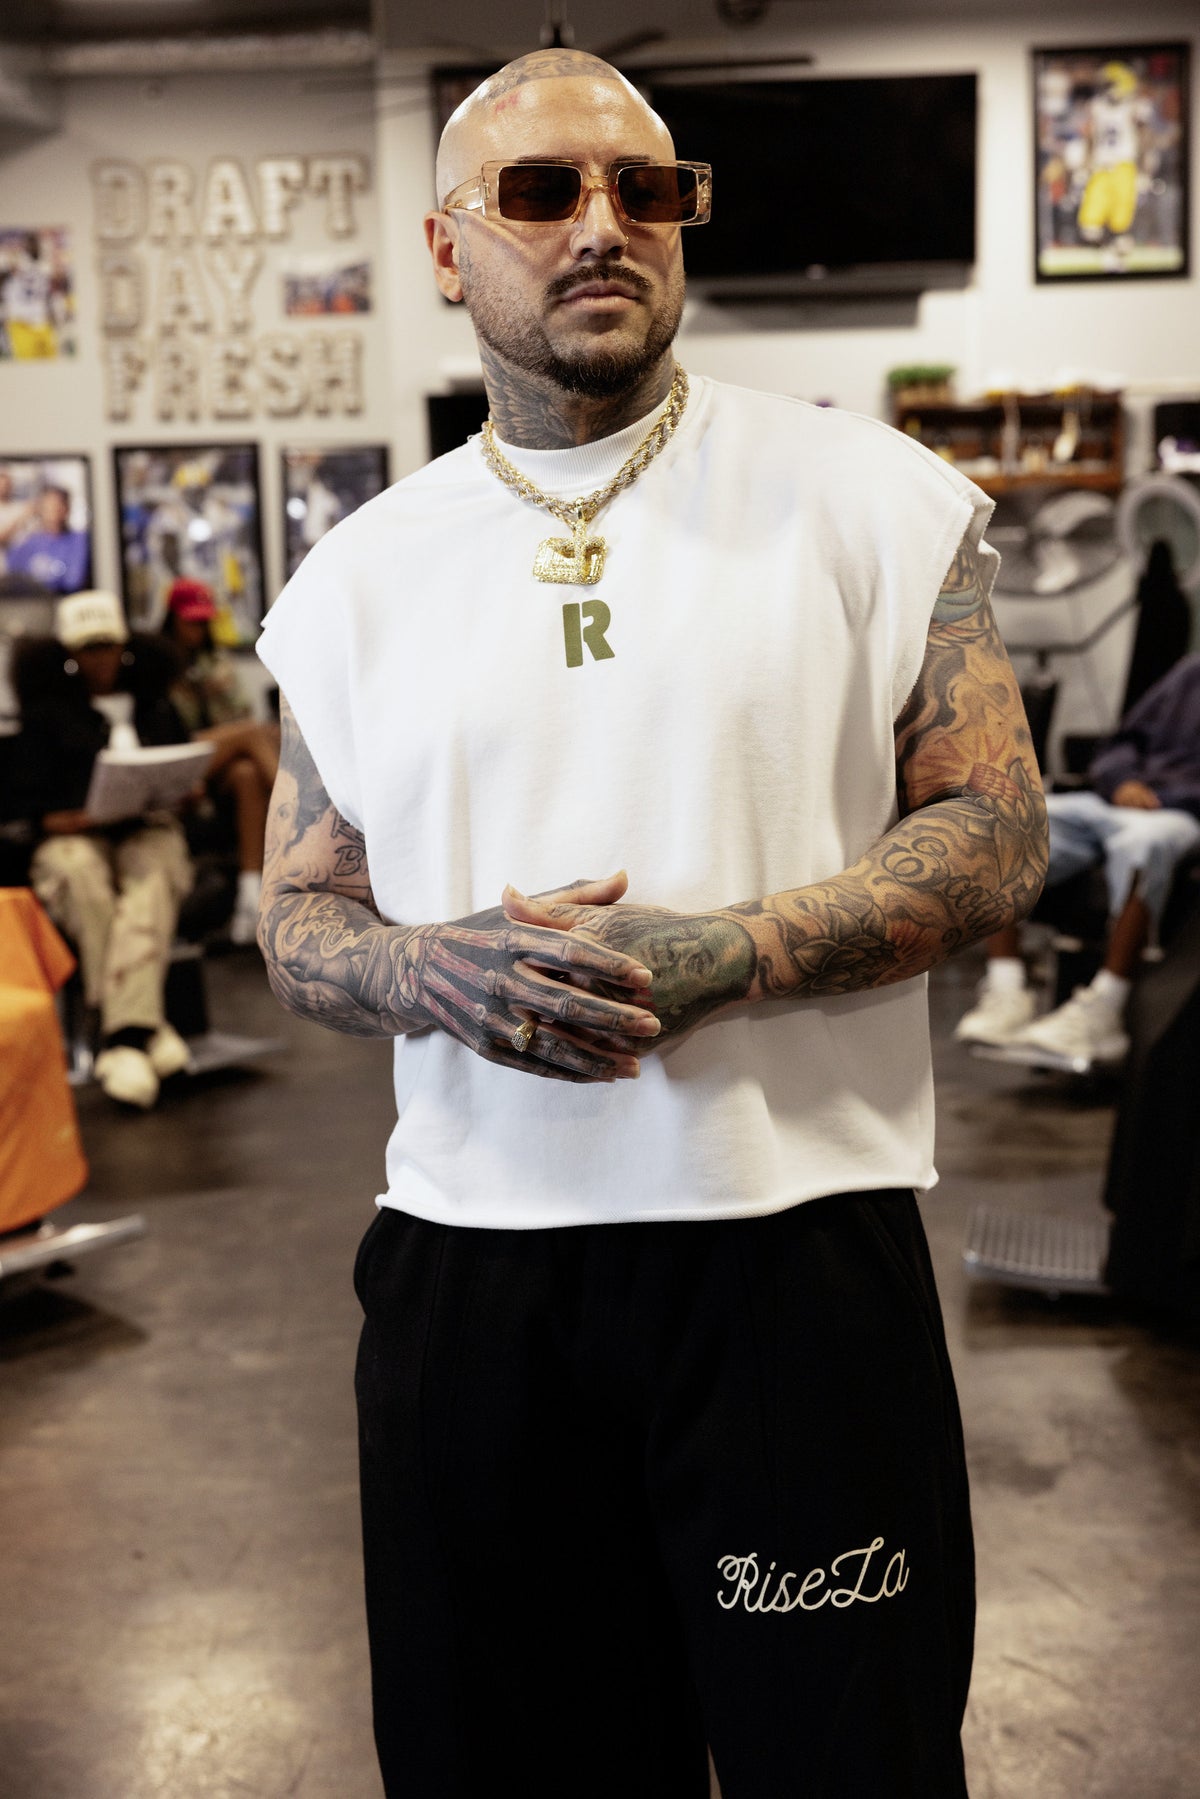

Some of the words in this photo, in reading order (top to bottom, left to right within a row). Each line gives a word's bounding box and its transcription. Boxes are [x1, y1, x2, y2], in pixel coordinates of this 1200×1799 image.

[92, 154, 373, 247] DRAFT
[97, 250, 262, 336] DAY
[102, 334, 364, 421] FRESH
[562, 599, 616, 668] R
